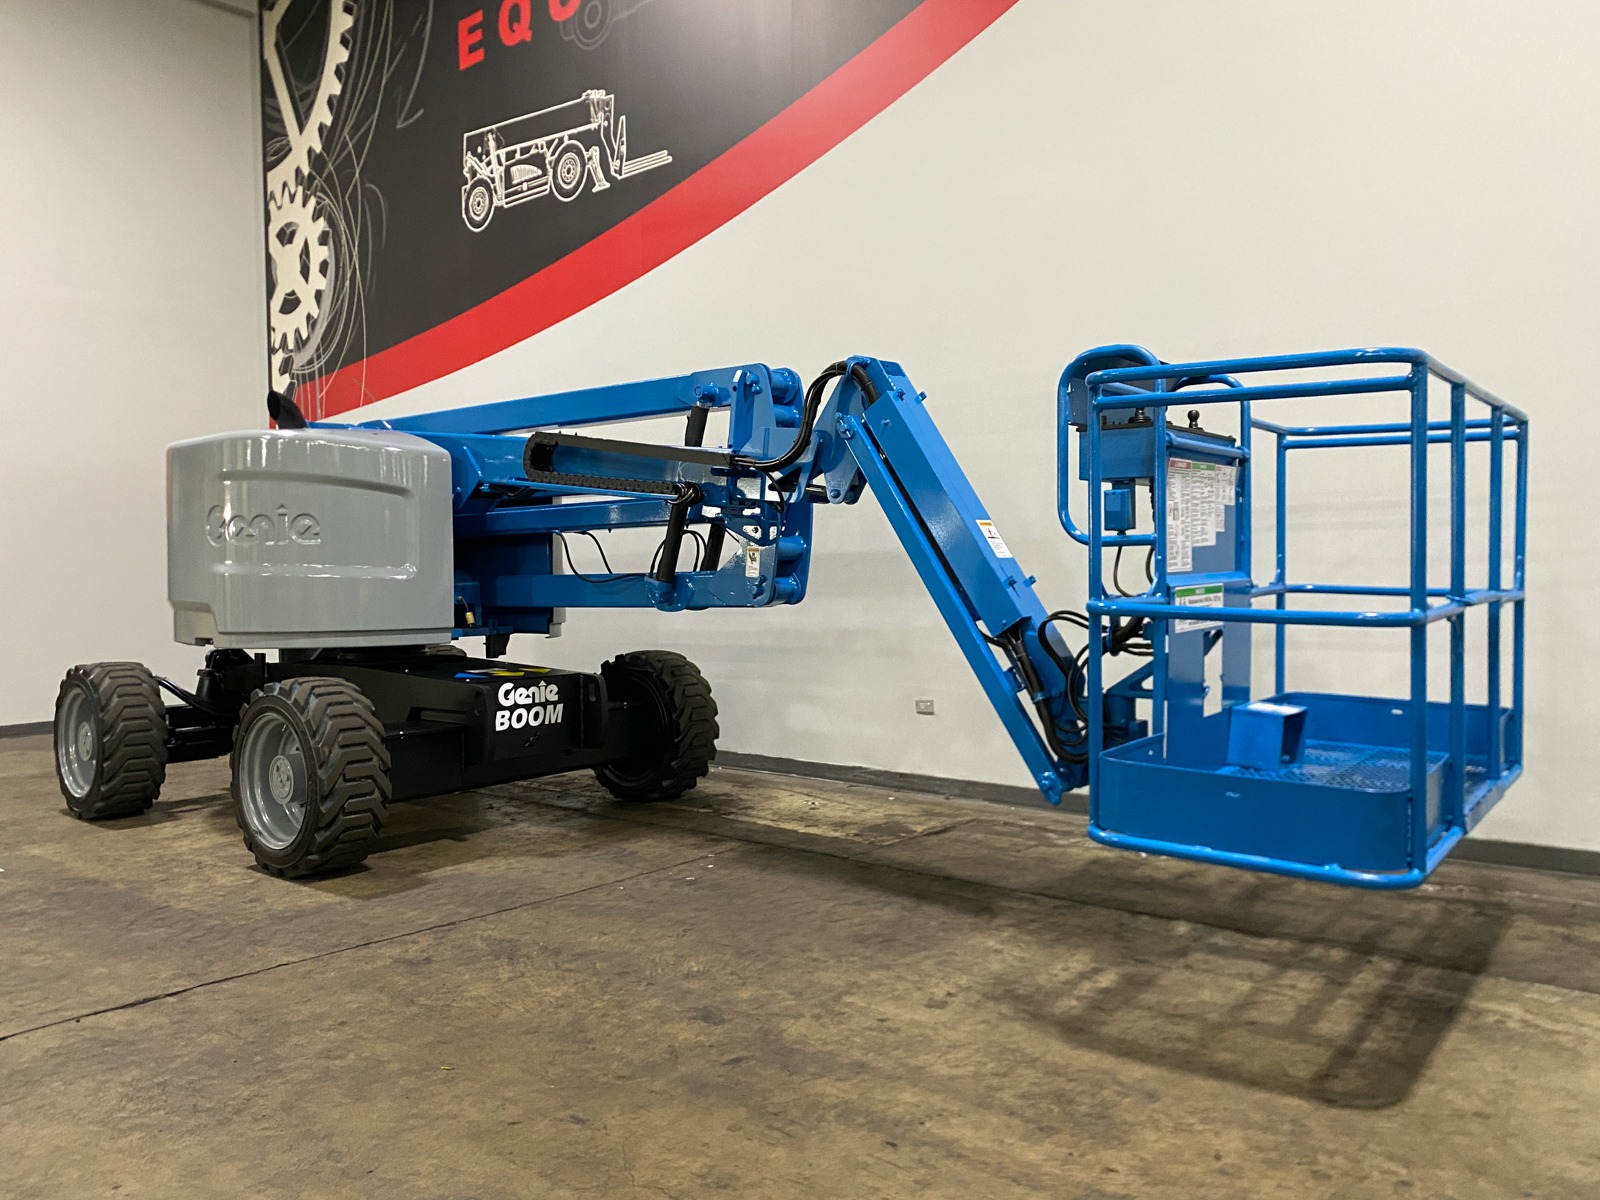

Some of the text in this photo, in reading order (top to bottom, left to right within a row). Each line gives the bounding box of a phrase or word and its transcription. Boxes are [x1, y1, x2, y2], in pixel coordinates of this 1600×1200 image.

[205, 504, 321, 547] Genie
[498, 680, 559, 707] Genie
[495, 703, 564, 731] BOOM
